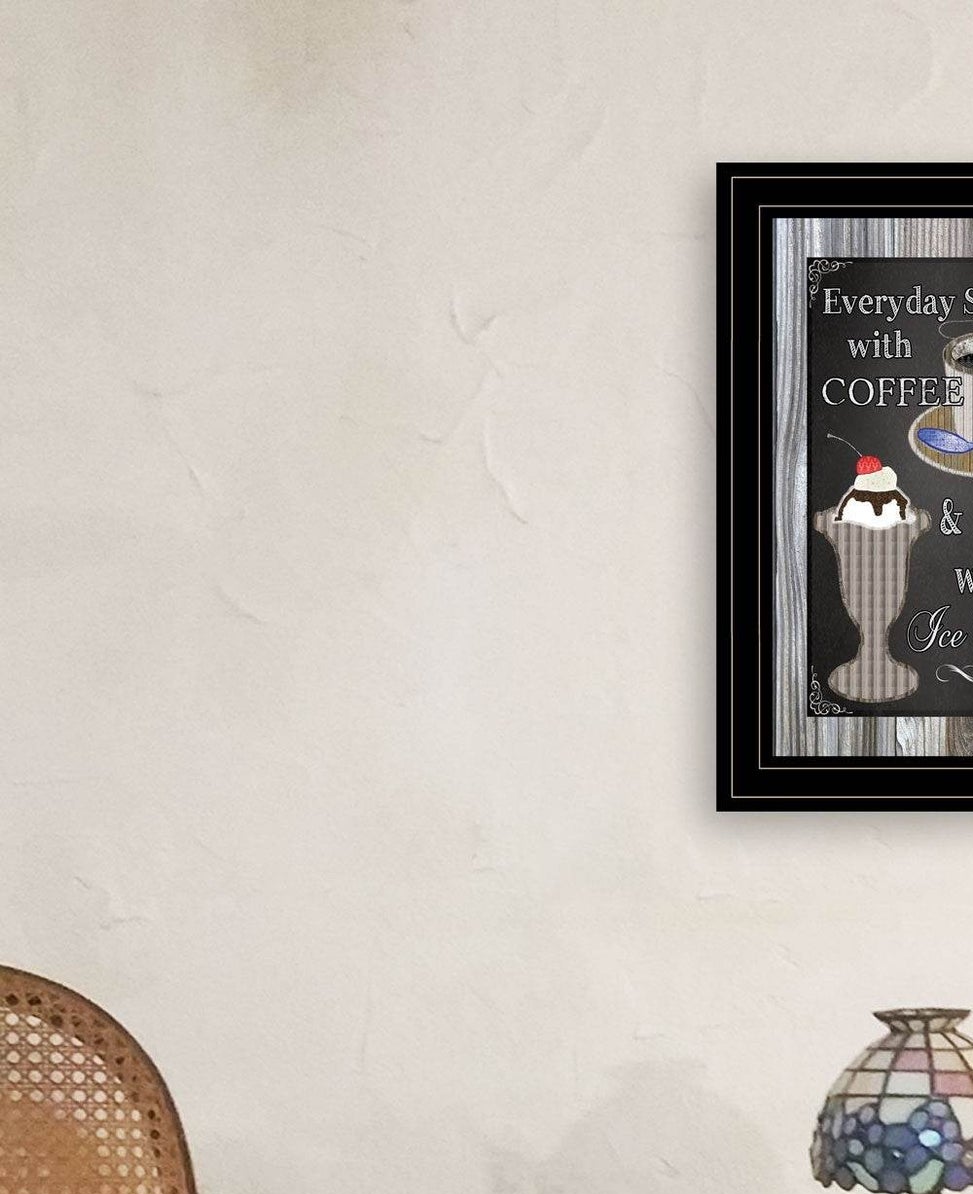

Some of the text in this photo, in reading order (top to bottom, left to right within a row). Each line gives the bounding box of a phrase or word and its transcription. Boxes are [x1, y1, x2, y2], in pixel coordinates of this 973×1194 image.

[822, 286, 954, 321] Everyday
[848, 331, 913, 359] with
[822, 377, 964, 407] COFFEE
[940, 498, 963, 535] &
[907, 606, 968, 652] Ice
